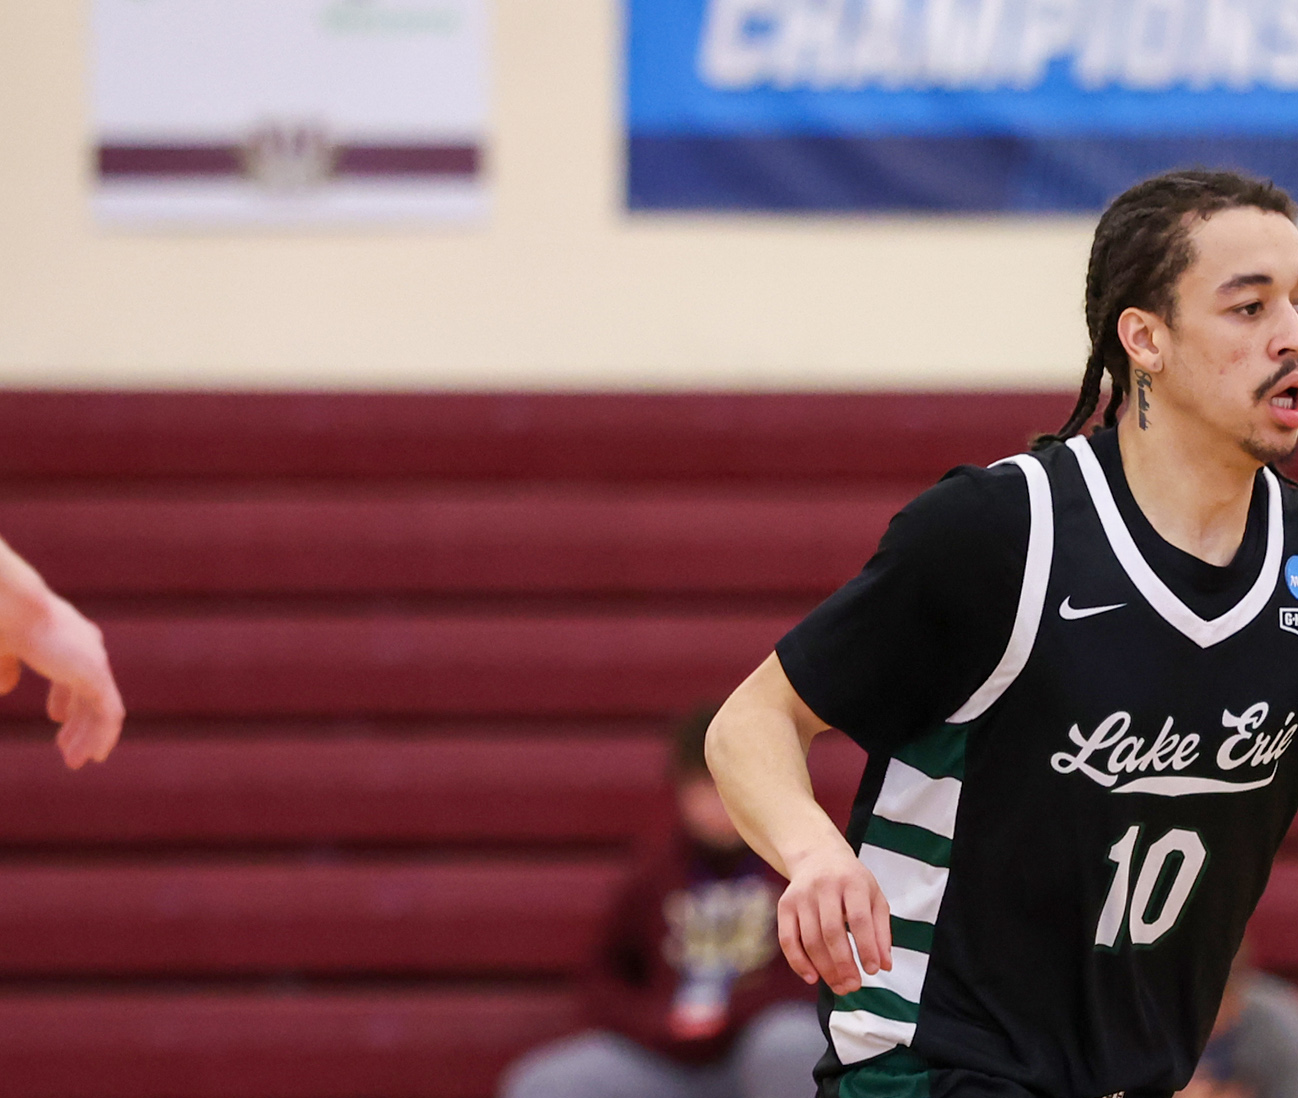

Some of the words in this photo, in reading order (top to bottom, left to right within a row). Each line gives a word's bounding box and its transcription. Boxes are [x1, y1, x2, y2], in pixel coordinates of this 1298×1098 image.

[1050, 711, 1200, 787] Lake
[1216, 701, 1298, 771] Erie
[1094, 824, 1208, 948] 10
